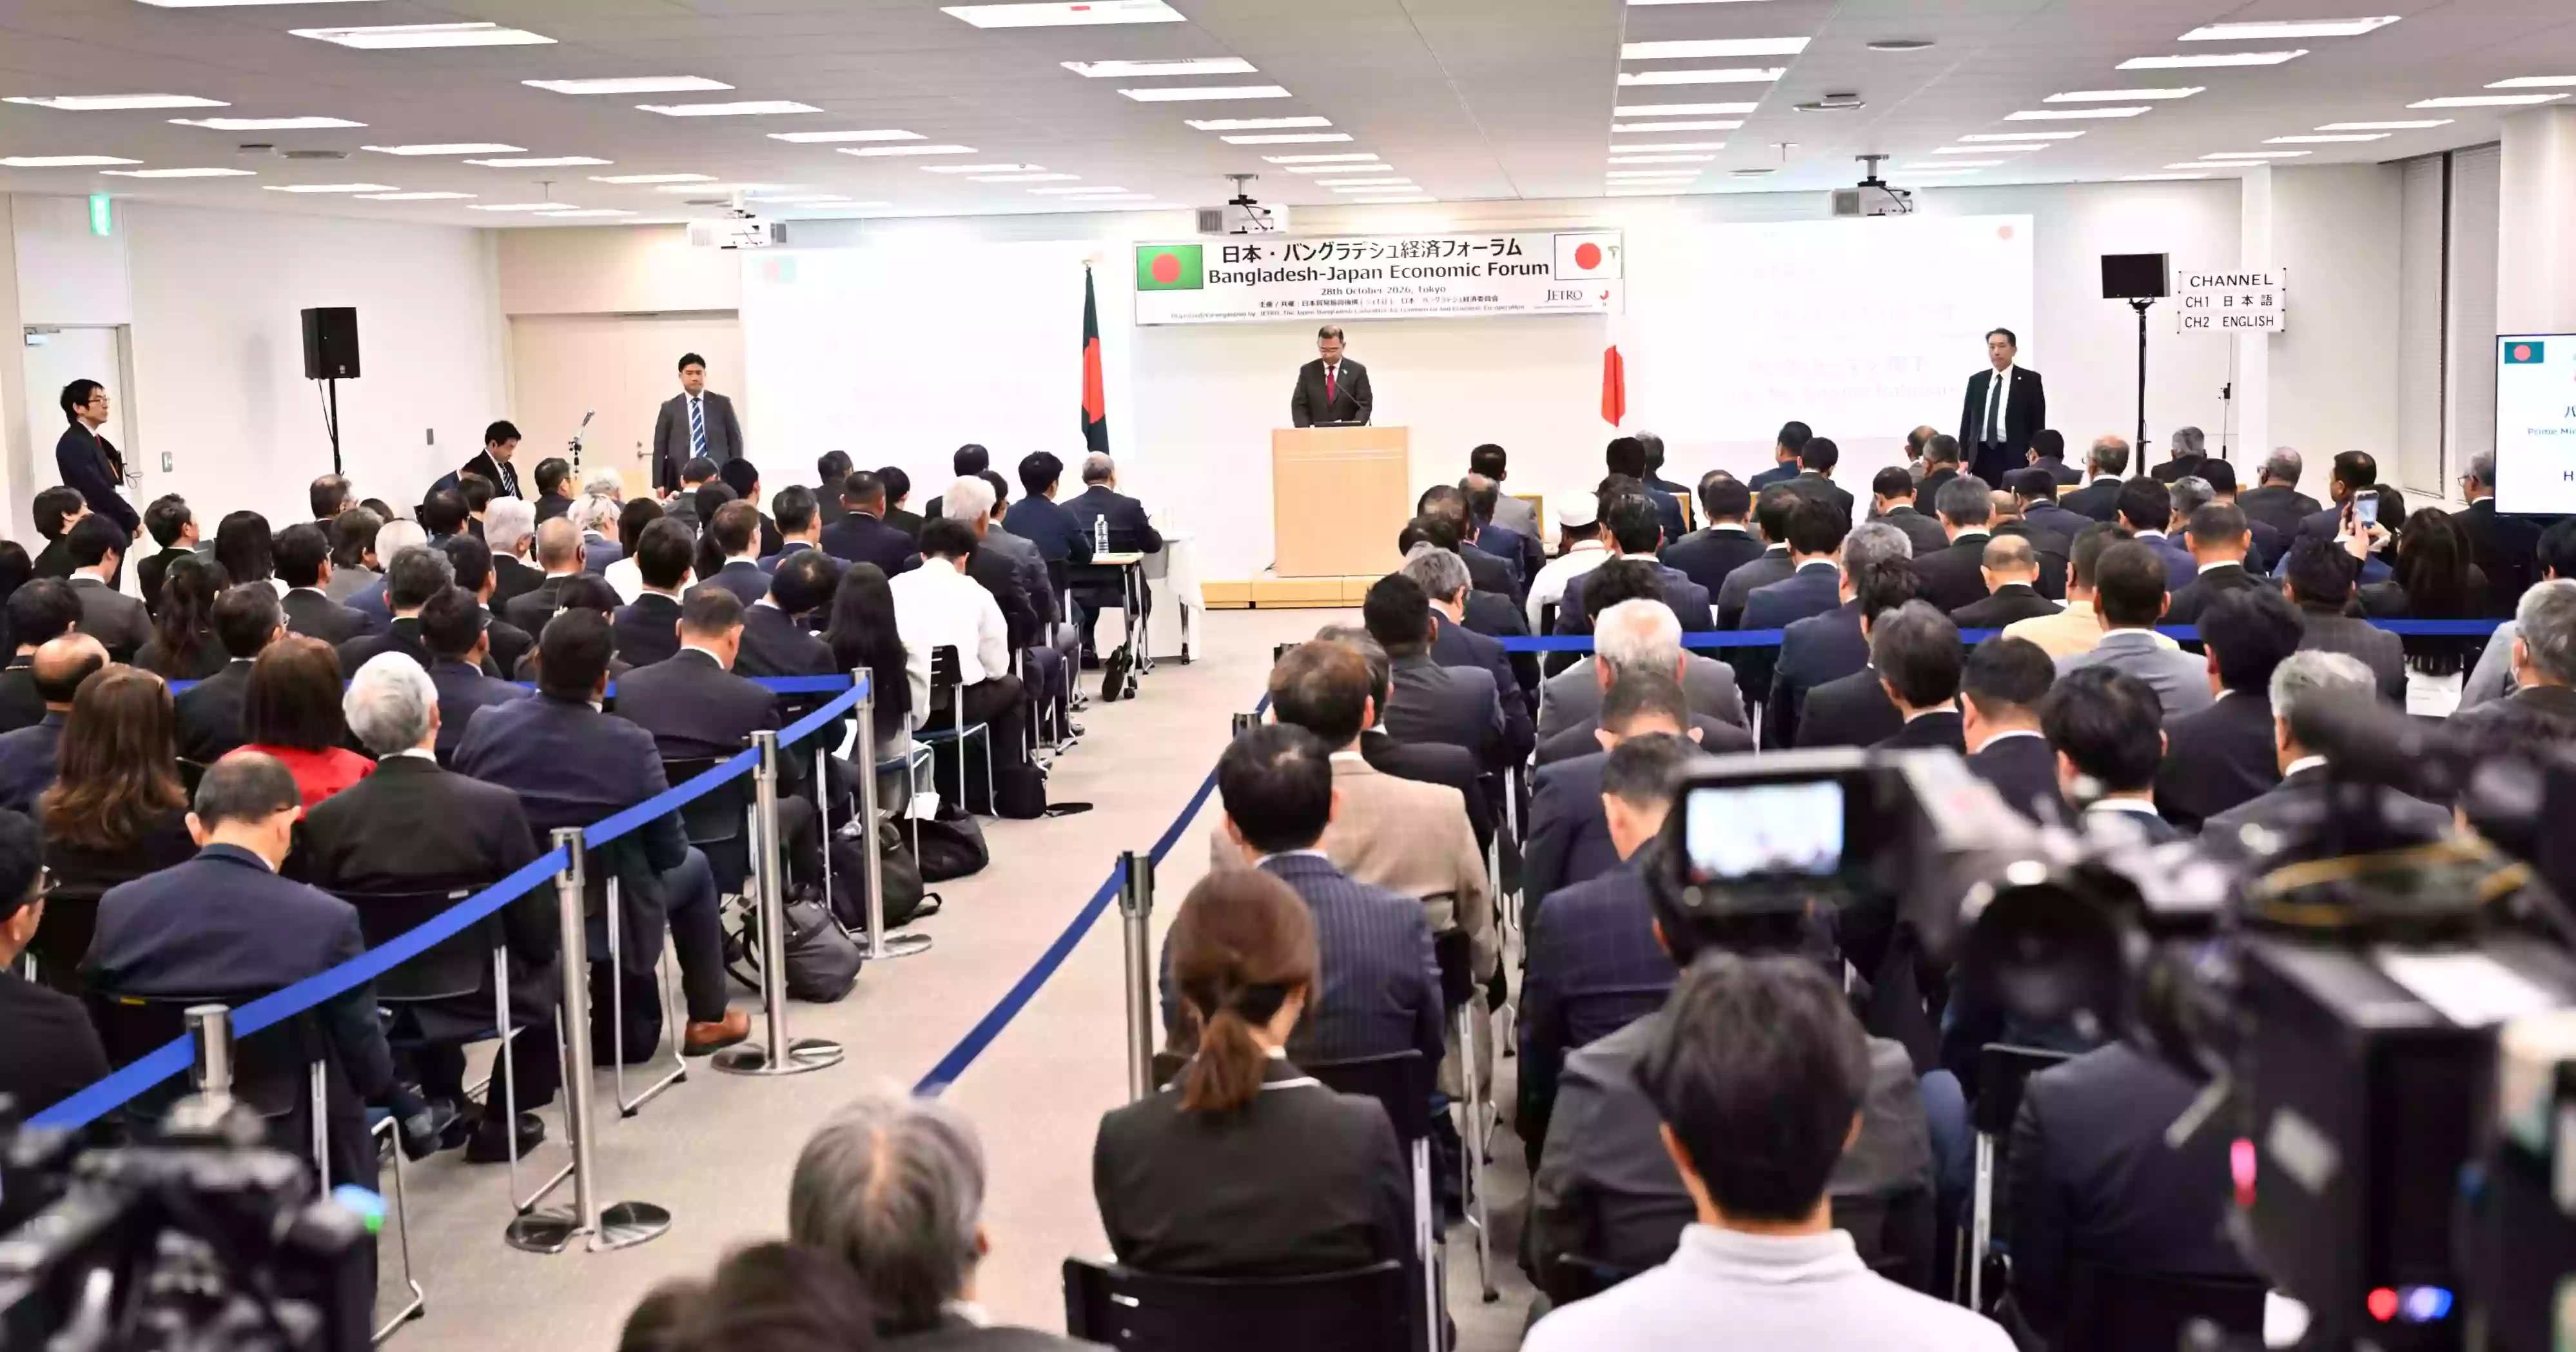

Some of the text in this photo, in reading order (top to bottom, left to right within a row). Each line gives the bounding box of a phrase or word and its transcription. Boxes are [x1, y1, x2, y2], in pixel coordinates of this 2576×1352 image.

[1222, 237, 1523, 264] 日本・バングラデシュ経済フォーラム
[1209, 262, 1549, 286] Bangladesh-Japan Economic Forum
[2191, 274, 2274, 288] CHANNEL
[1545, 289, 1583, 302] JETRO
[2223, 315, 2274, 327] ENGLISH
